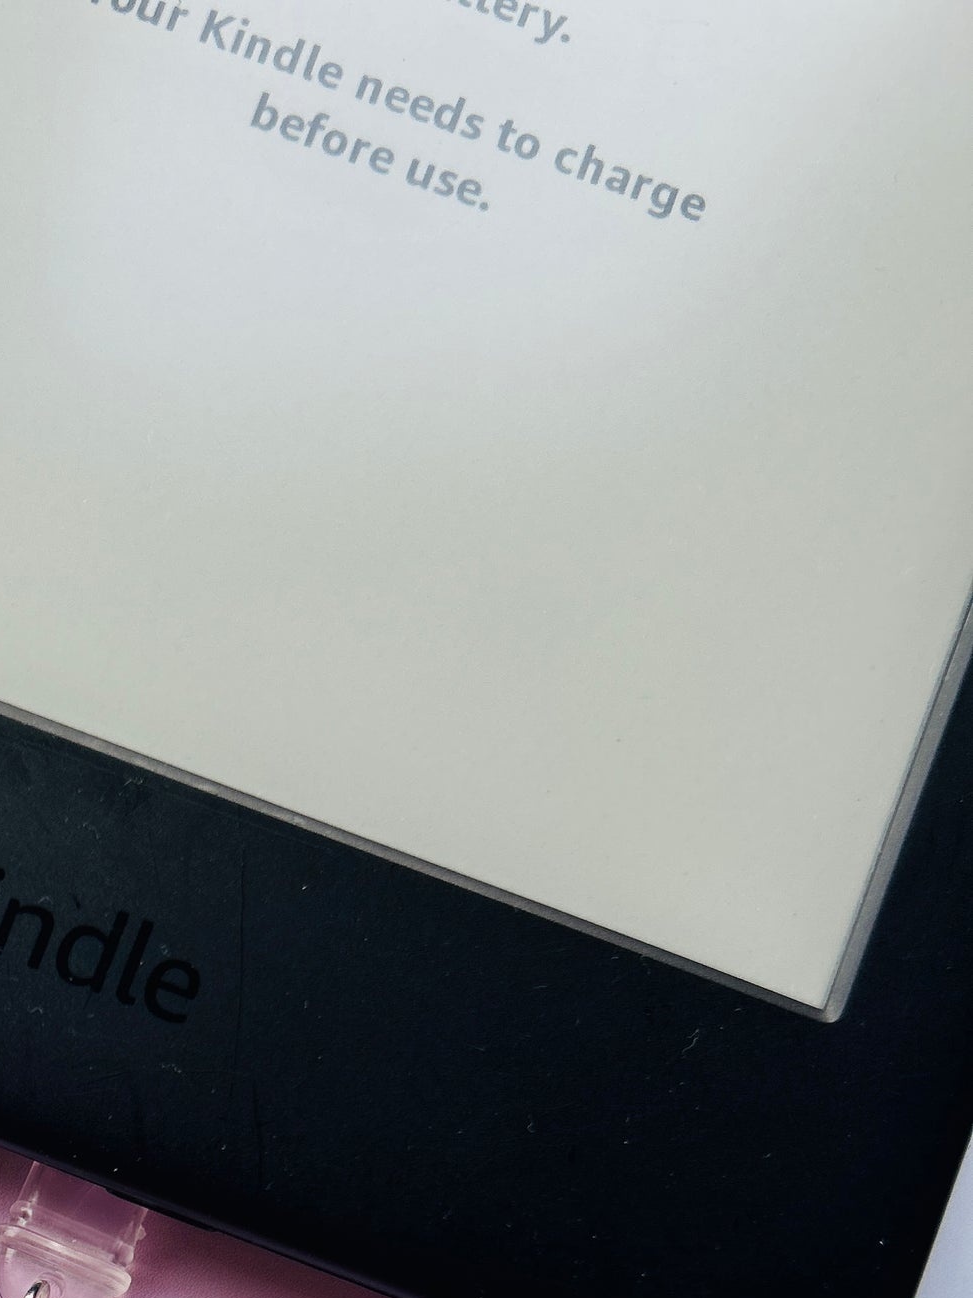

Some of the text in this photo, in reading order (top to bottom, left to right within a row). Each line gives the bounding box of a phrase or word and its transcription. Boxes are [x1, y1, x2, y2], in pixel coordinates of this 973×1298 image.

[89, 0, 707, 221] our Kindle needs to charge
[250, 92, 490, 212] before use.
